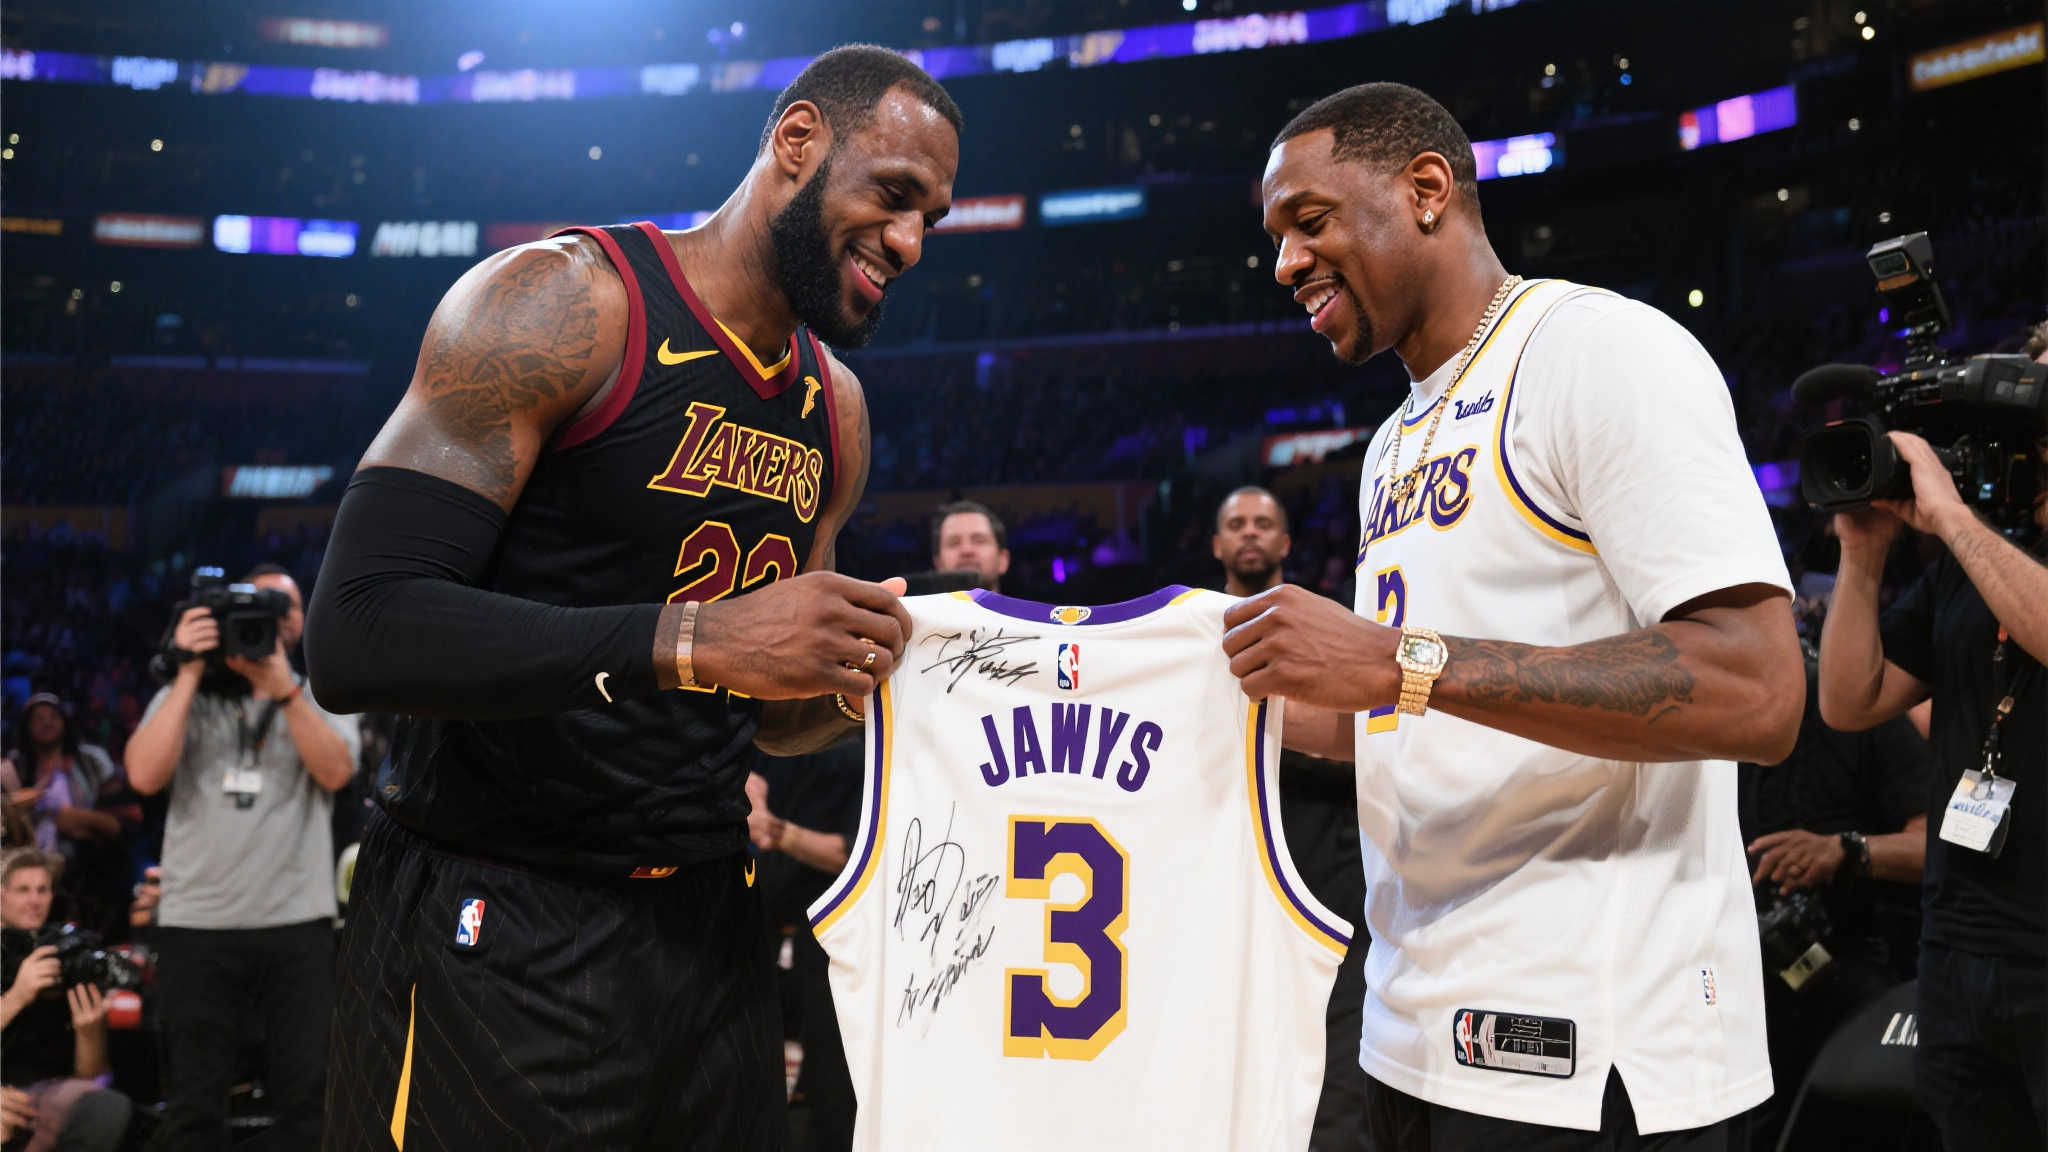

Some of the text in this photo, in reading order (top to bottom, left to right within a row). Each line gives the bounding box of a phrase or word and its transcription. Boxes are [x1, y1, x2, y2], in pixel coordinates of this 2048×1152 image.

[647, 401, 823, 523] LAKERS
[979, 702, 1164, 793] JAWYS
[1003, 814, 1131, 1061] 3
